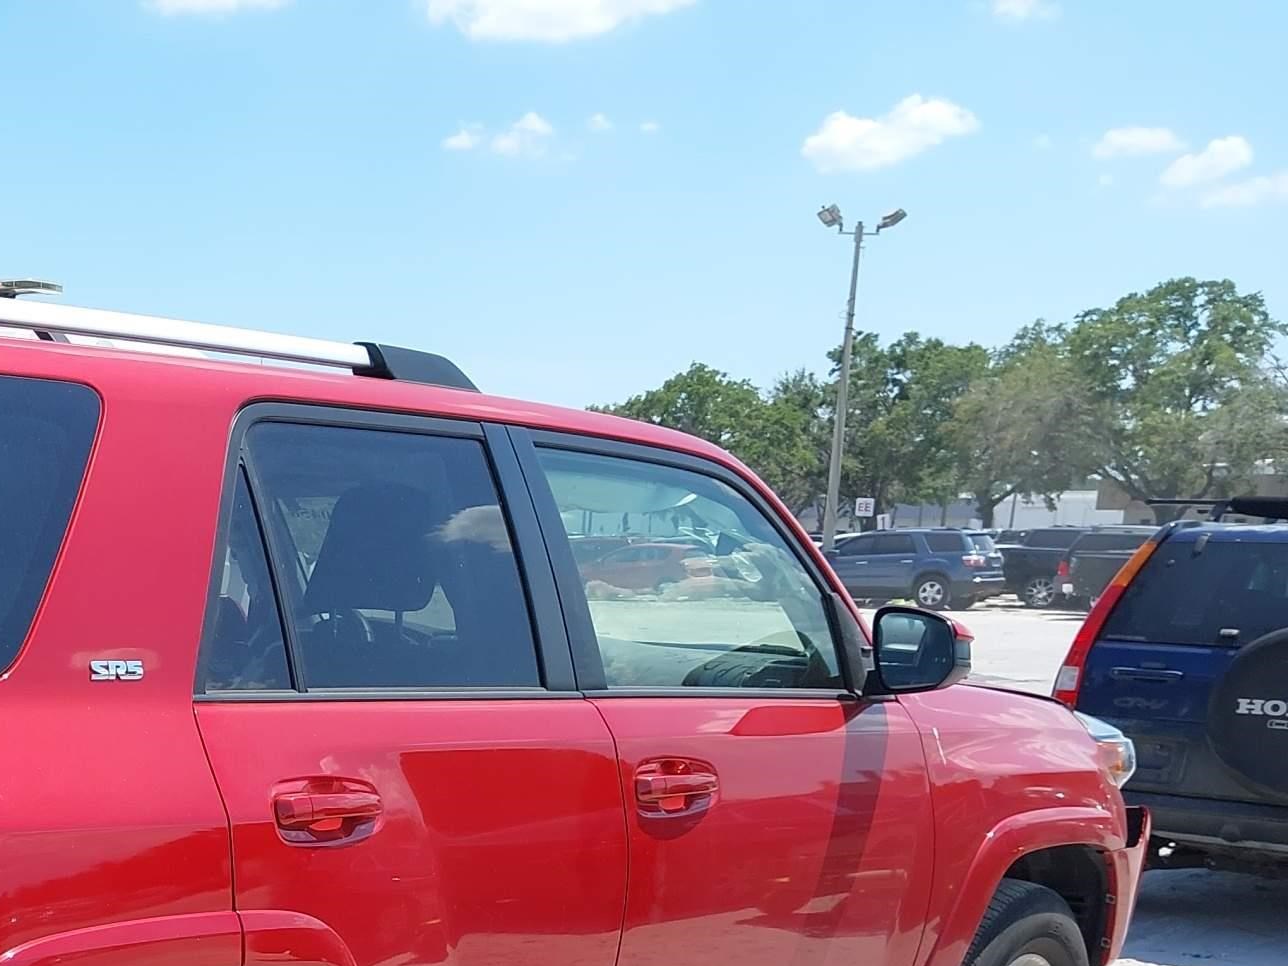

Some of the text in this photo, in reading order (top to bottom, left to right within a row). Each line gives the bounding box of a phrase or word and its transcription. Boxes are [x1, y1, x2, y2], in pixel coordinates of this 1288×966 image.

[857, 502, 872, 513] EE
[90, 660, 144, 681] SR5
[1235, 698, 1288, 718] HO
